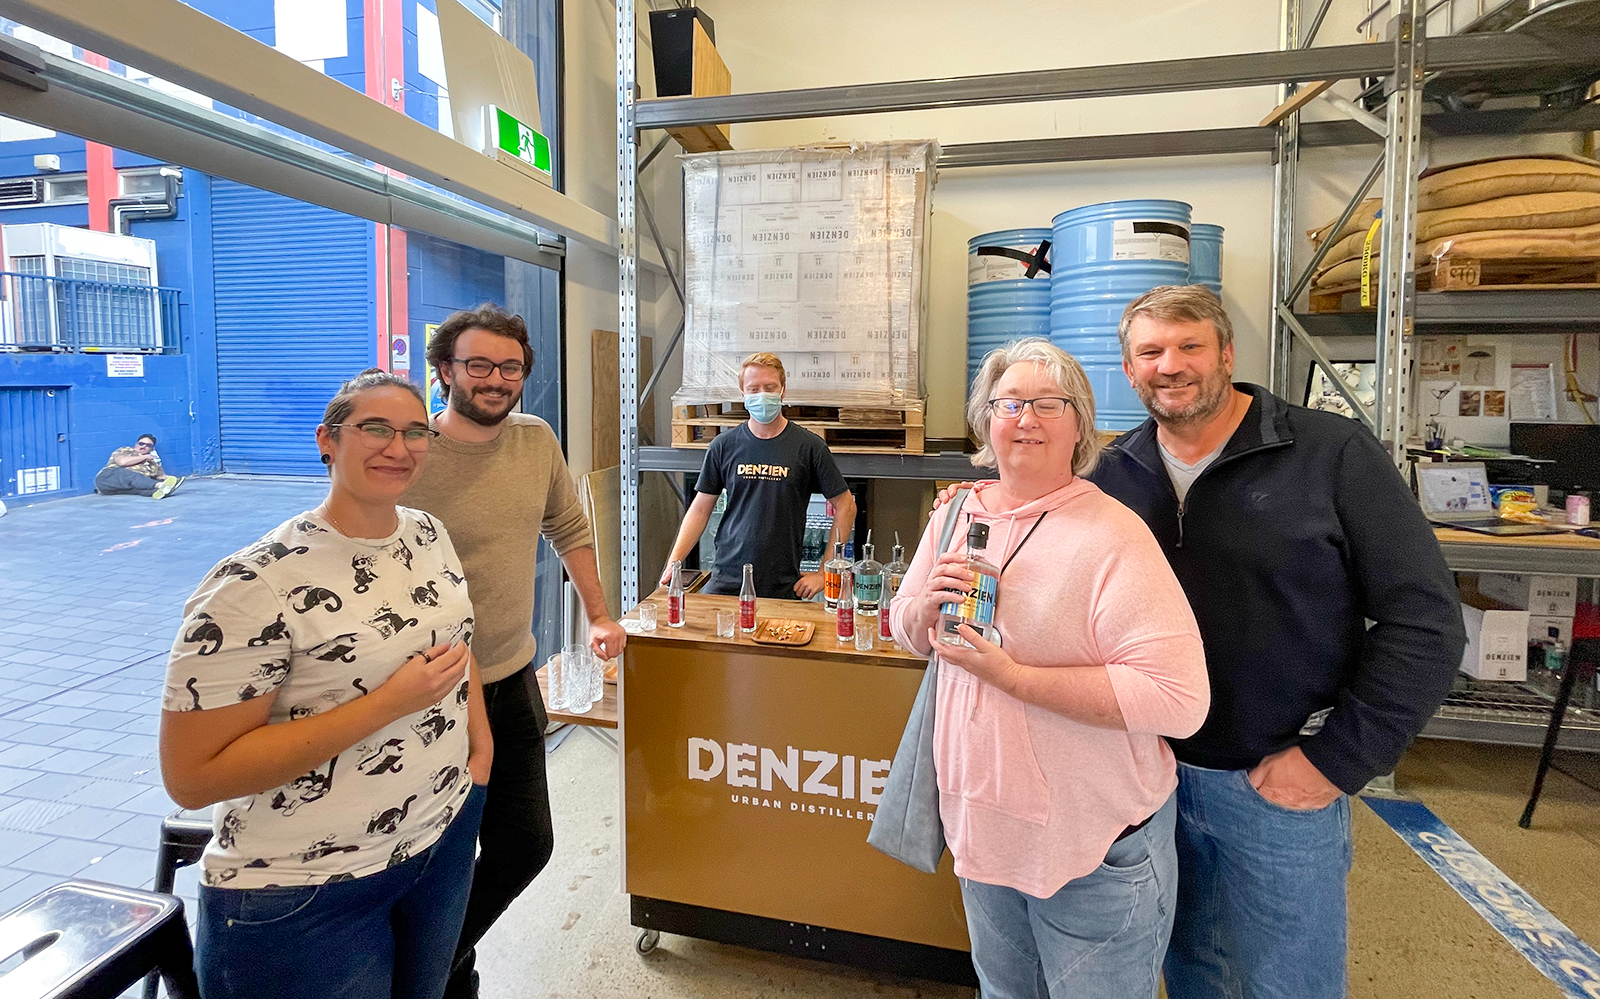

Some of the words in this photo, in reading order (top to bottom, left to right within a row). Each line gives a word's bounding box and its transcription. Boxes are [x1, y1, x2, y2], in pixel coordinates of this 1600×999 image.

[766, 172, 796, 180] DENZIEN
[806, 170, 837, 179] DENZIEN
[847, 168, 878, 177] DENZIEN
[728, 174, 757, 183] DENZIEN
[752, 232, 790, 242] DENZIEN
[809, 230, 849, 240] DENZIEN
[764, 272, 793, 280] DENZIEN
[803, 272, 833, 280] DENZIEN
[749, 331, 787, 340] DENZIEN
[807, 330, 847, 340] DENZIEN
[801, 371, 831, 379] DENZIEN
[840, 371, 871, 379] DENZIEN
[737, 463, 789, 478] DENZIEN
[1485, 653, 1521, 661] DENZIEN
[687, 736, 892, 805] DENZIE
[731, 794, 783, 810] URBAN
[790, 801, 876, 822] DISTILLER
